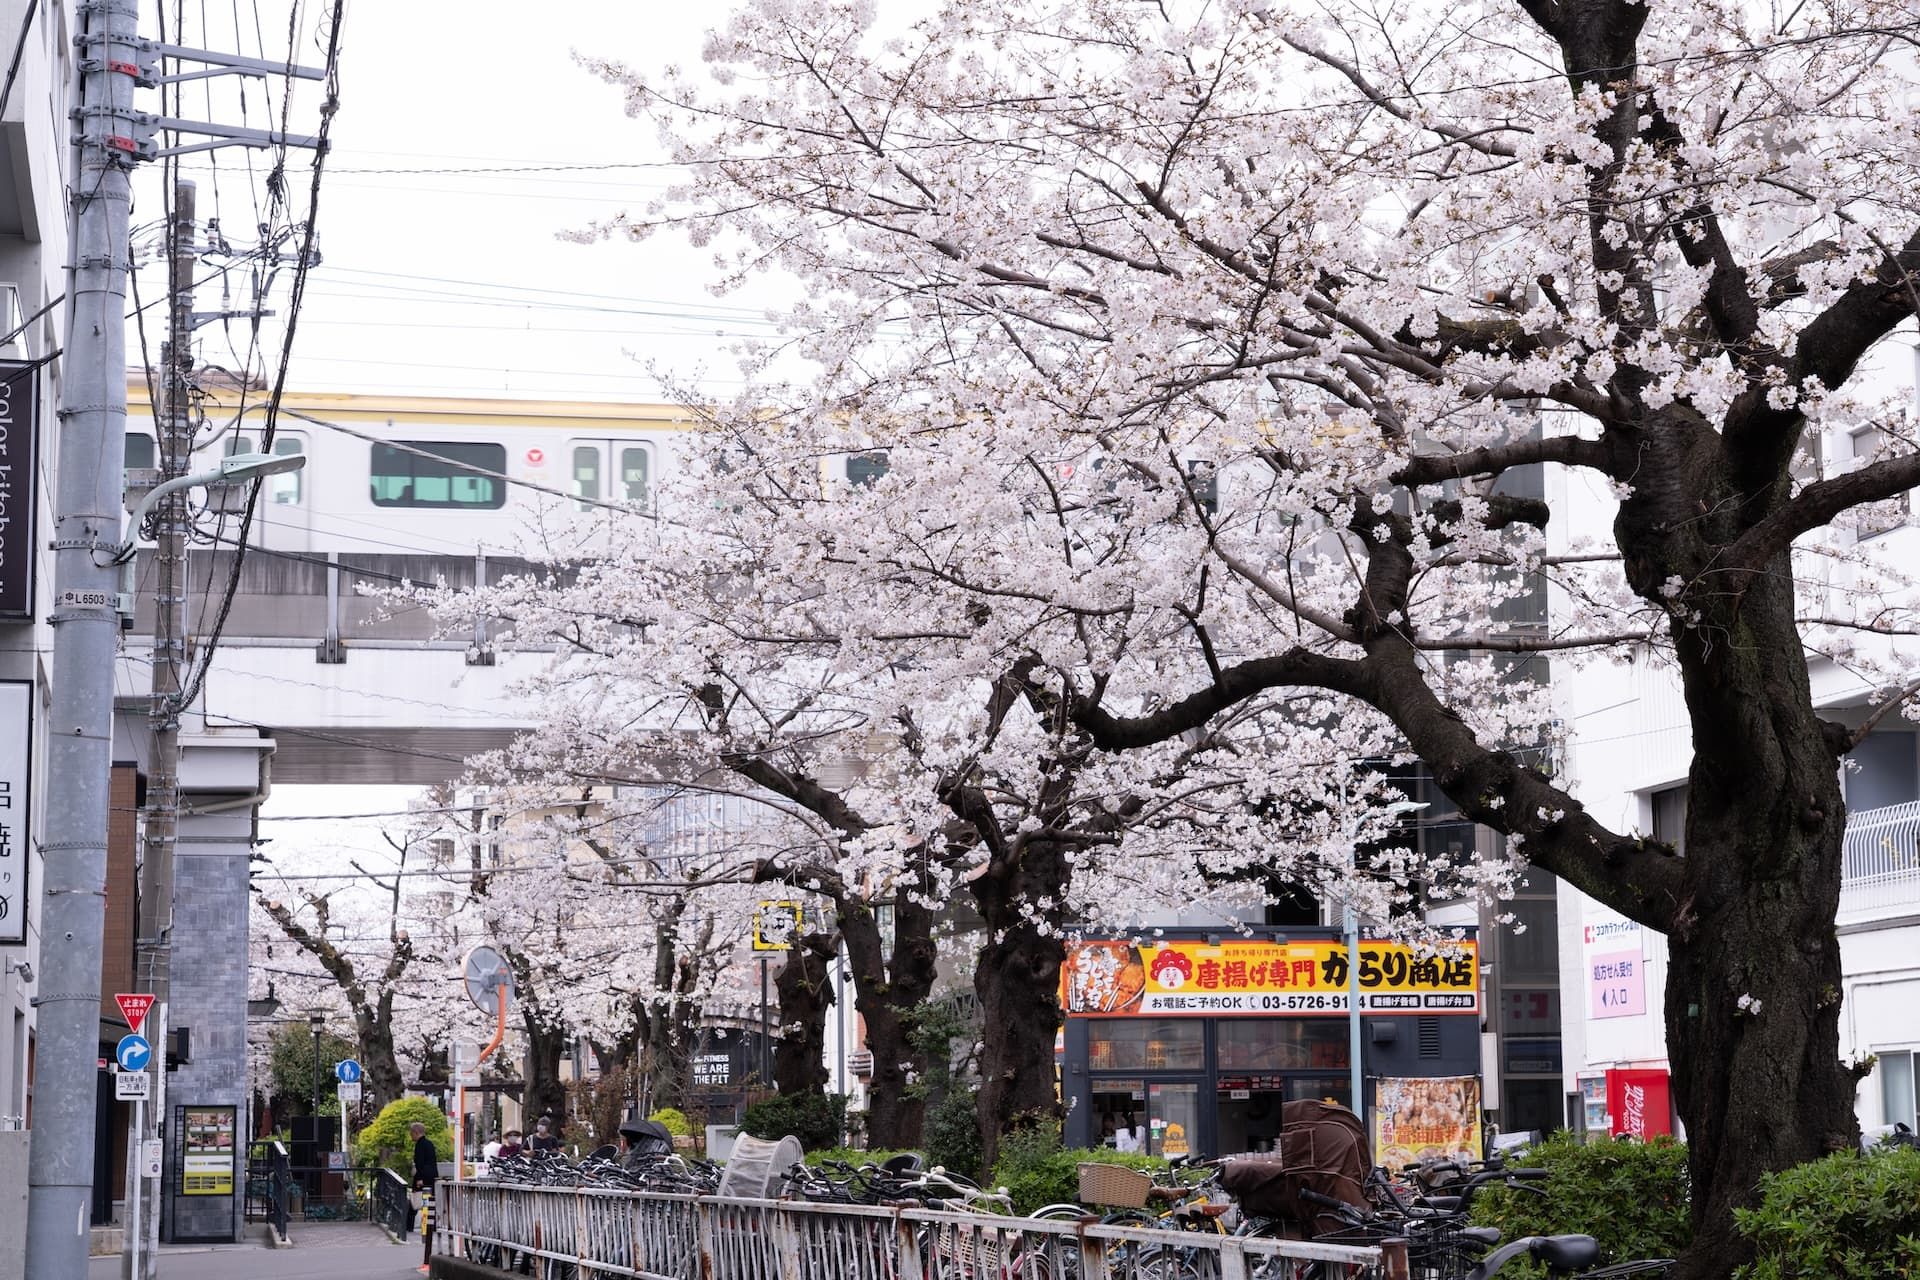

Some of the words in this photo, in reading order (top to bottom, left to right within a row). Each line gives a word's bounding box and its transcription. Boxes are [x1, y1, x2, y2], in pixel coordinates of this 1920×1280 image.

[1196, 959, 1316, 989] 唐揚げ専門
[1594, 960, 1632, 981] 処方せん受付
[1611, 988, 1627, 1006] 入口
[123, 999, 147, 1008] 止まれ
[1152, 997, 1242, 1009] お電話ご予約OK
[1262, 996, 1366, 1009] 03-5726-914
[127, 1009, 144, 1017] STOP
[704, 1055, 729, 1063] FITNESS
[694, 1064, 707, 1074] WE
[710, 1064, 729, 1074] ARE
[694, 1075, 710, 1085] THE
[711, 1075, 729, 1085] FIT
[119, 1083, 147, 1091] 一方通行
[1624, 1082, 1644, 1136] oca-Cola
